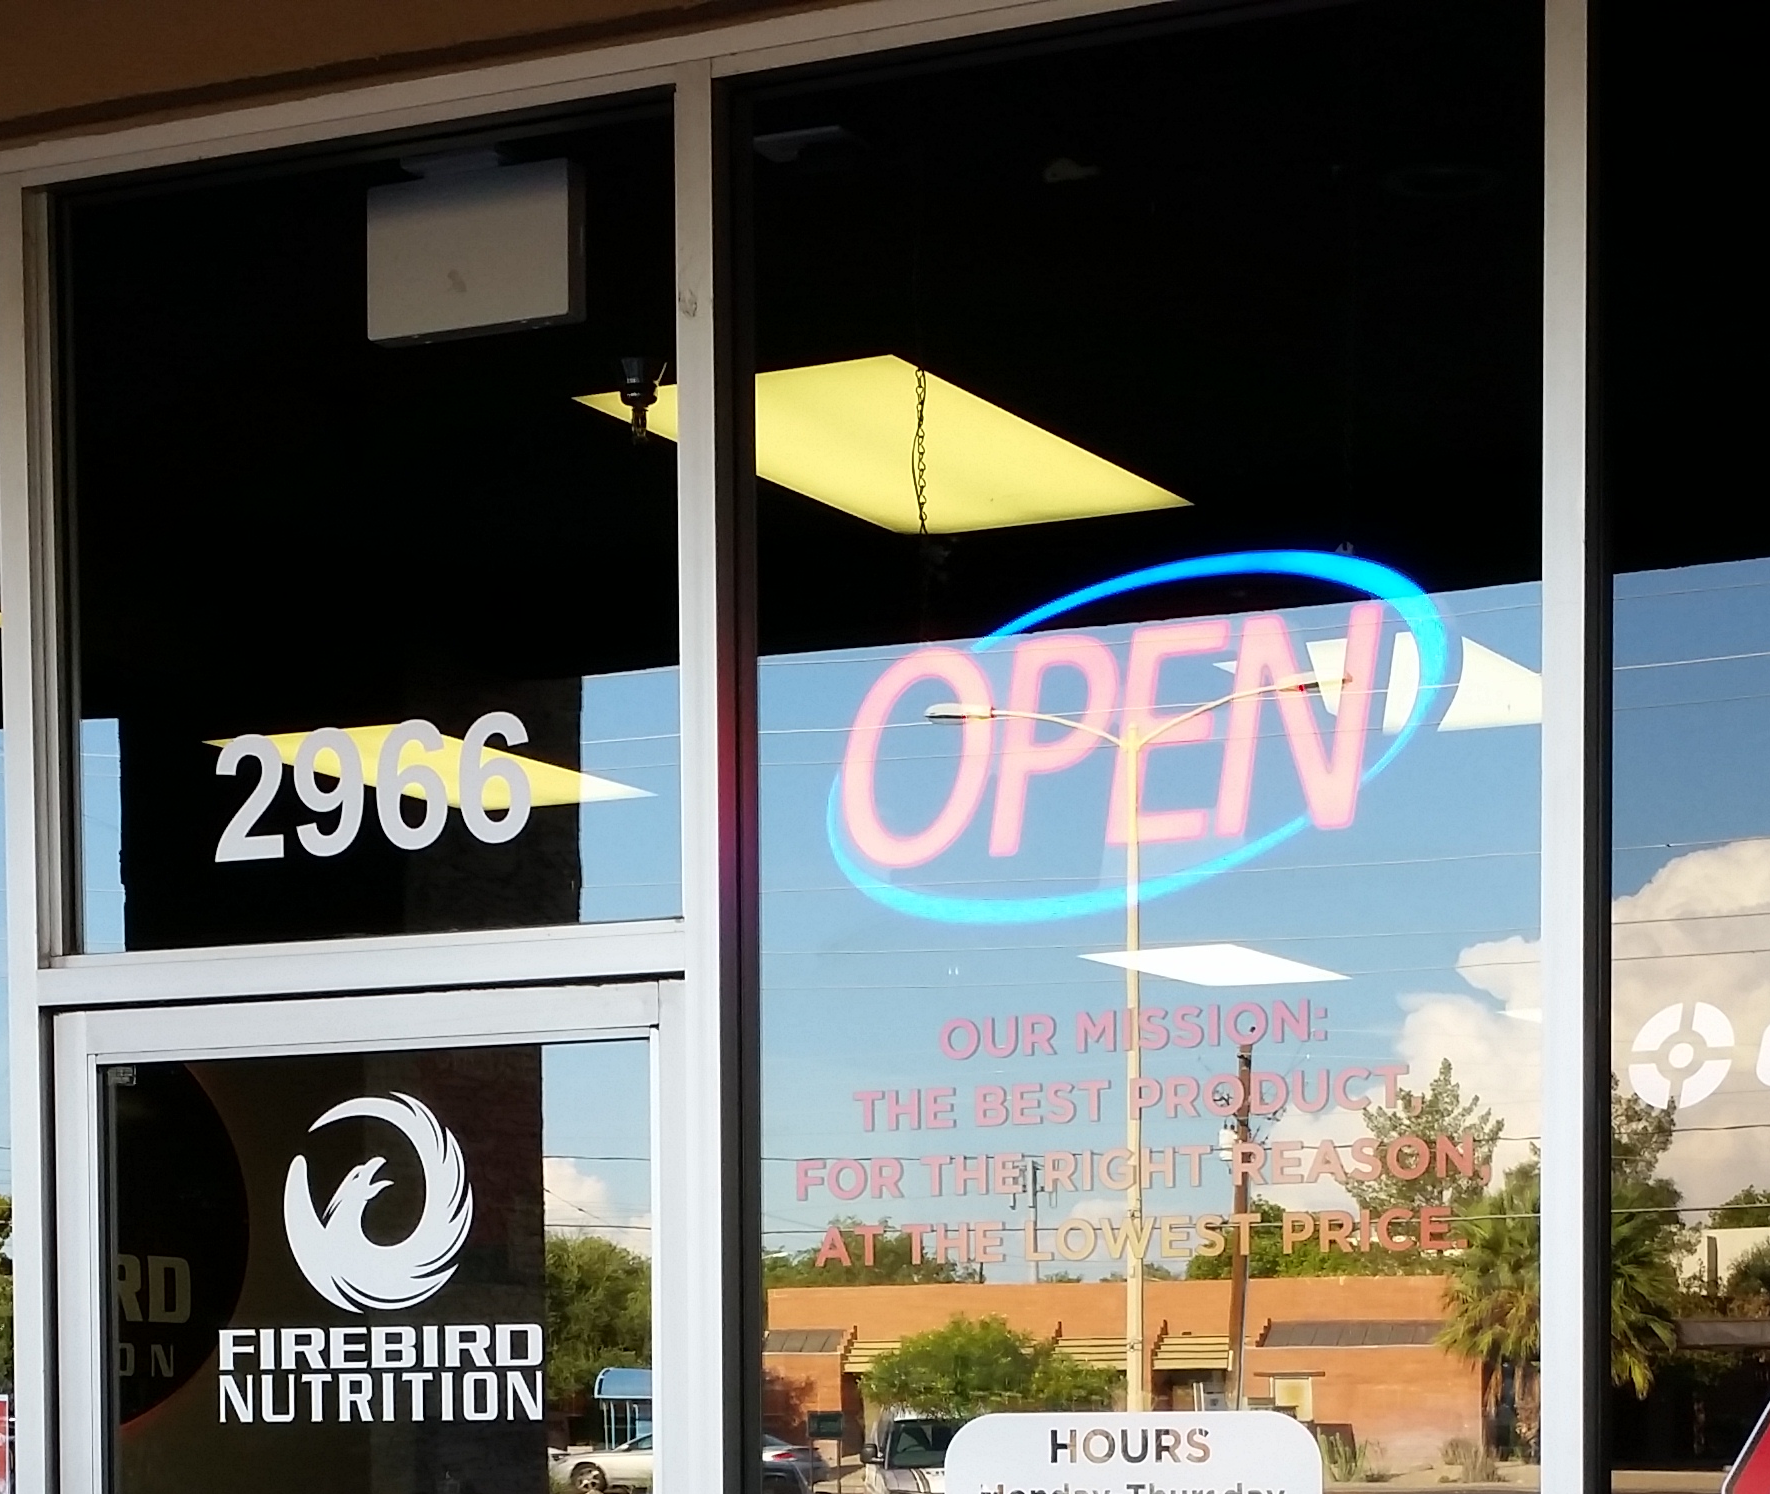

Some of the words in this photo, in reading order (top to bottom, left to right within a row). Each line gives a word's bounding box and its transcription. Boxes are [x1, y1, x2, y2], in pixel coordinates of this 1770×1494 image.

[841, 604, 1383, 870] OPEN
[214, 711, 532, 863] 2966
[939, 1012, 1058, 1060] OUR
[1076, 999, 1329, 1053] MISSION:
[853, 1087, 957, 1133] THE
[974, 1078, 1112, 1130] BEST
[1129, 1064, 1423, 1120] PRODUCT,
[795, 1158, 904, 1202] FOR
[921, 1152, 1028, 1197] THE
[1042, 1144, 1213, 1193] RIGHT
[1230, 1134, 1492, 1189] REASON,
[815, 1225, 886, 1268] AT
[900, 1221, 1005, 1266] THE
[1023, 1212, 1262, 1261] LOWEST
[1282, 1205, 1469, 1254] PRICE.
[219, 1323, 543, 1371] FIREBIRD
[219, 1369, 543, 1424] NUTRITION
[1049, 1428, 1212, 1465] HOURS
